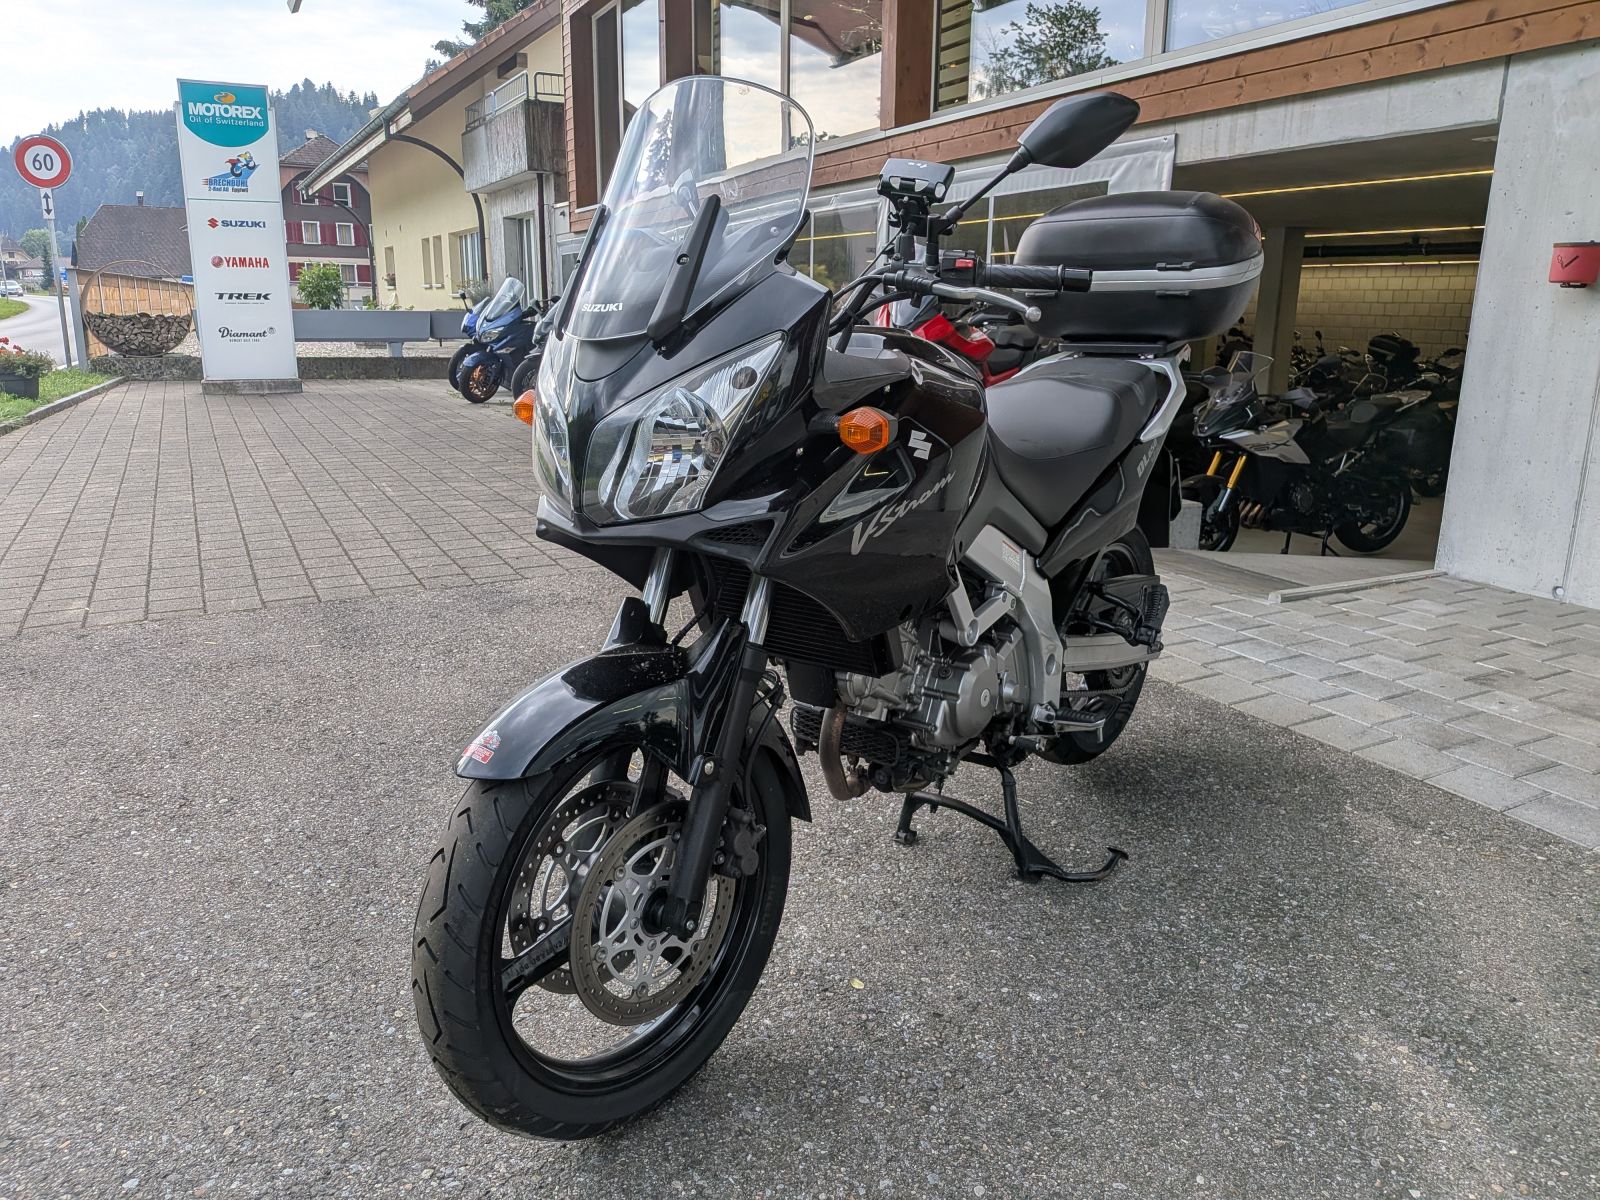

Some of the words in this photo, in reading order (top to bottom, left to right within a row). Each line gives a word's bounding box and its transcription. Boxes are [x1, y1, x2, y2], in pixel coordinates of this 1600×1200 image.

[187, 102, 263, 119] MOTOREX
[189, 115, 202, 123] Oil
[204, 116, 213, 124] of
[215, 117, 265, 127] Switzerland
[32, 153, 54, 172] 60
[221, 219, 266, 229] SUZUKI
[223, 256, 270, 269] YAMAHA
[214, 292, 273, 301] TREK
[581, 302, 624, 312] SUZUKI
[218, 326, 268, 338] Diamant
